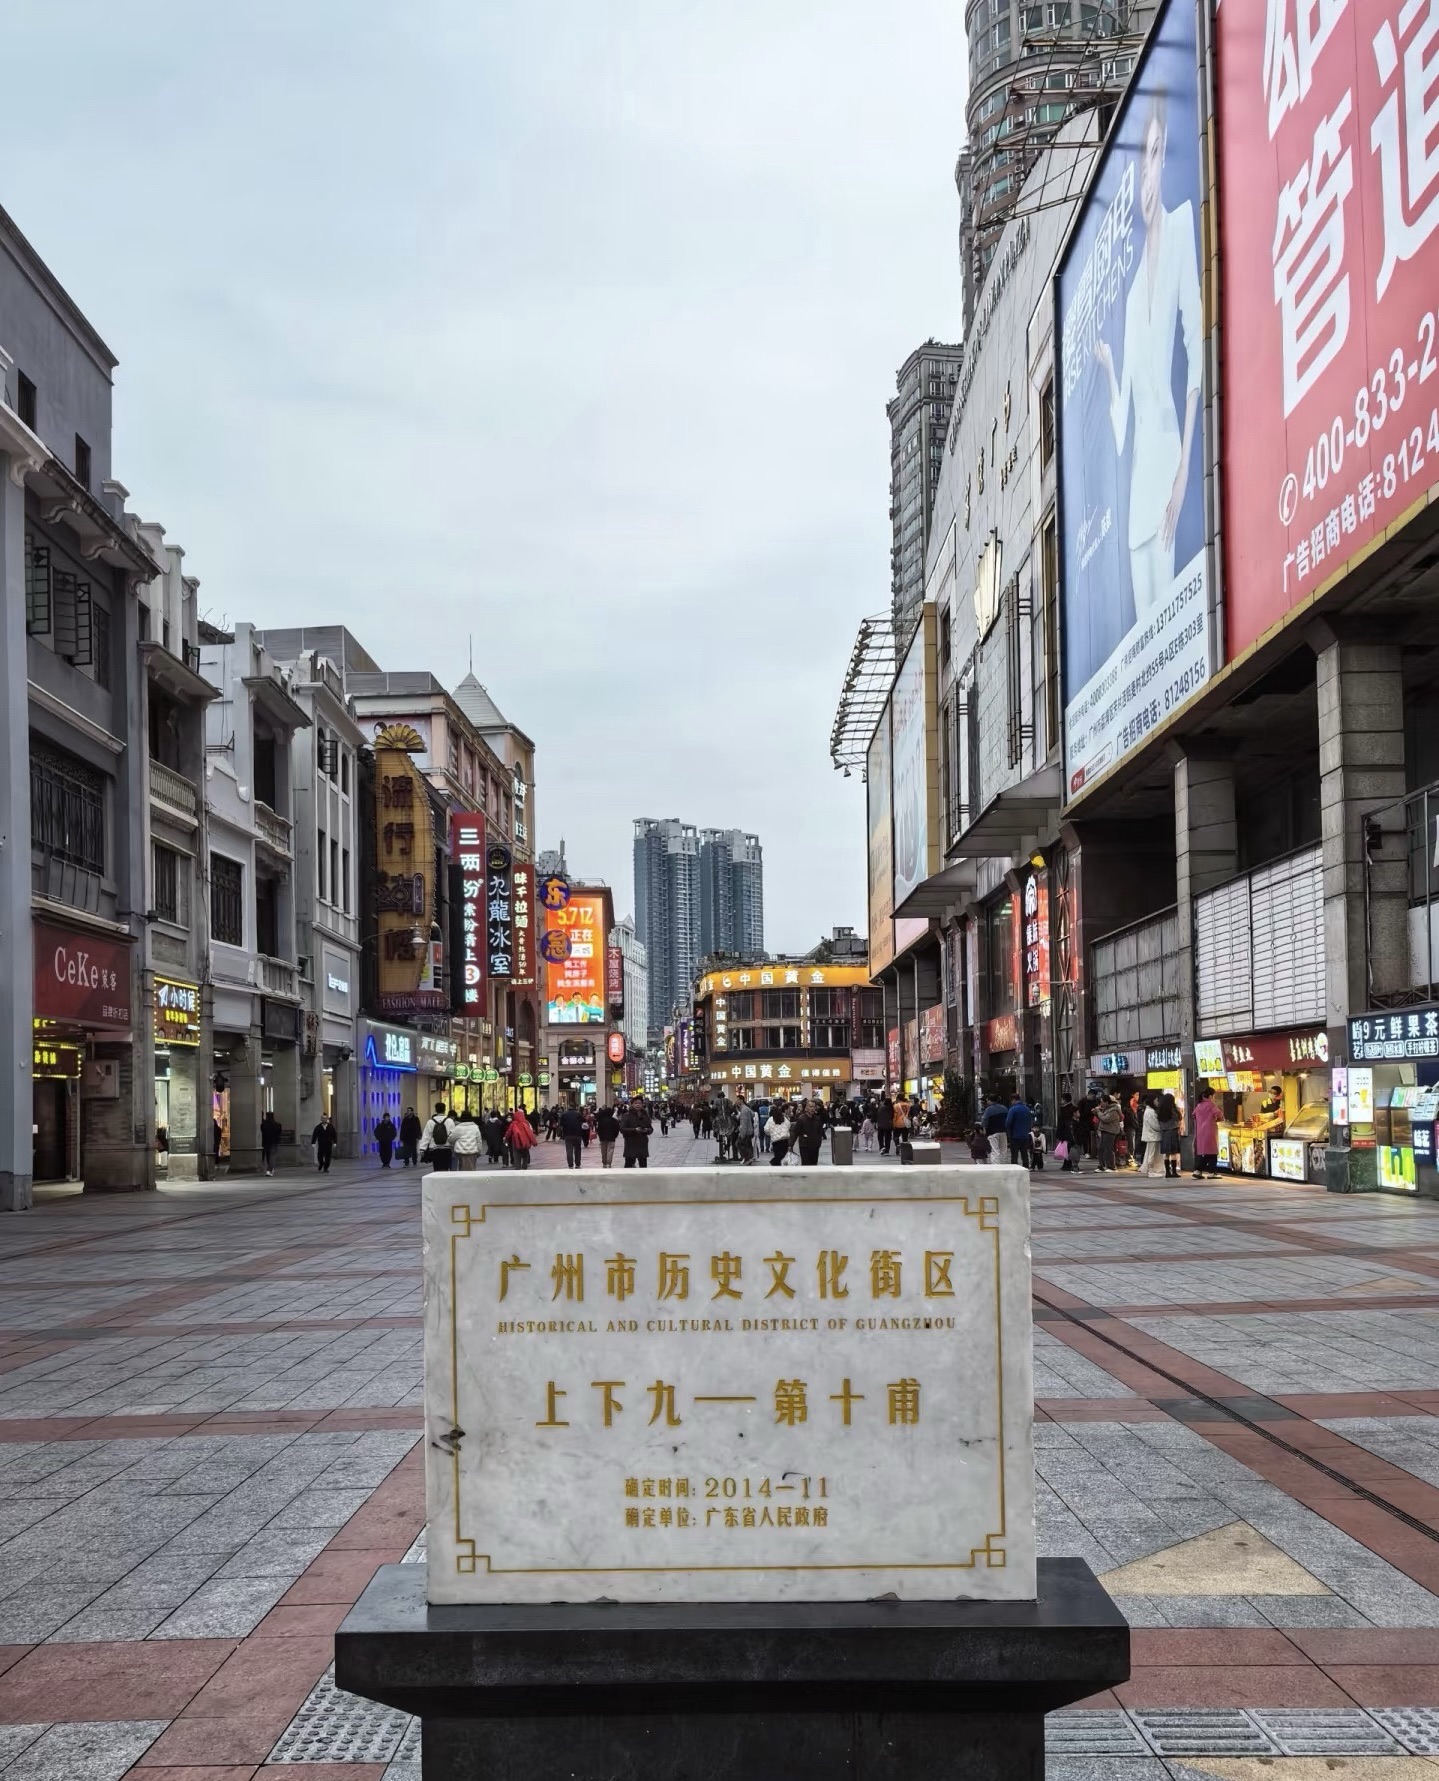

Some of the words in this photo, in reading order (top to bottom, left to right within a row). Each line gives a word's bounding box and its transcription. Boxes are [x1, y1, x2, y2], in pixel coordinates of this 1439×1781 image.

[1303, 308, 1439, 501] 400-833-2
[54, 946, 99, 989] CeKe
[740, 969, 825, 986] 中国黄金
[382, 996, 416, 1009] FASHION
[420, 996, 441, 1008] MALL
[715, 998, 726, 1047] 中国黄金
[1363, 1011, 1438, 1041] 9元鲜果茶
[732, 1064, 792, 1080] 中国黄金
[499, 1250, 955, 1303] 广州市历史文化街区
[498, 1319, 597, 1334] HISTORICAL
[606, 1319, 639, 1332] AND
[647, 1318, 733, 1332] CULTURAL
[742, 1318, 819, 1331] DISTRICT
[827, 1318, 848, 1331] OF
[856, 1316, 956, 1330] GUANGZHOU
